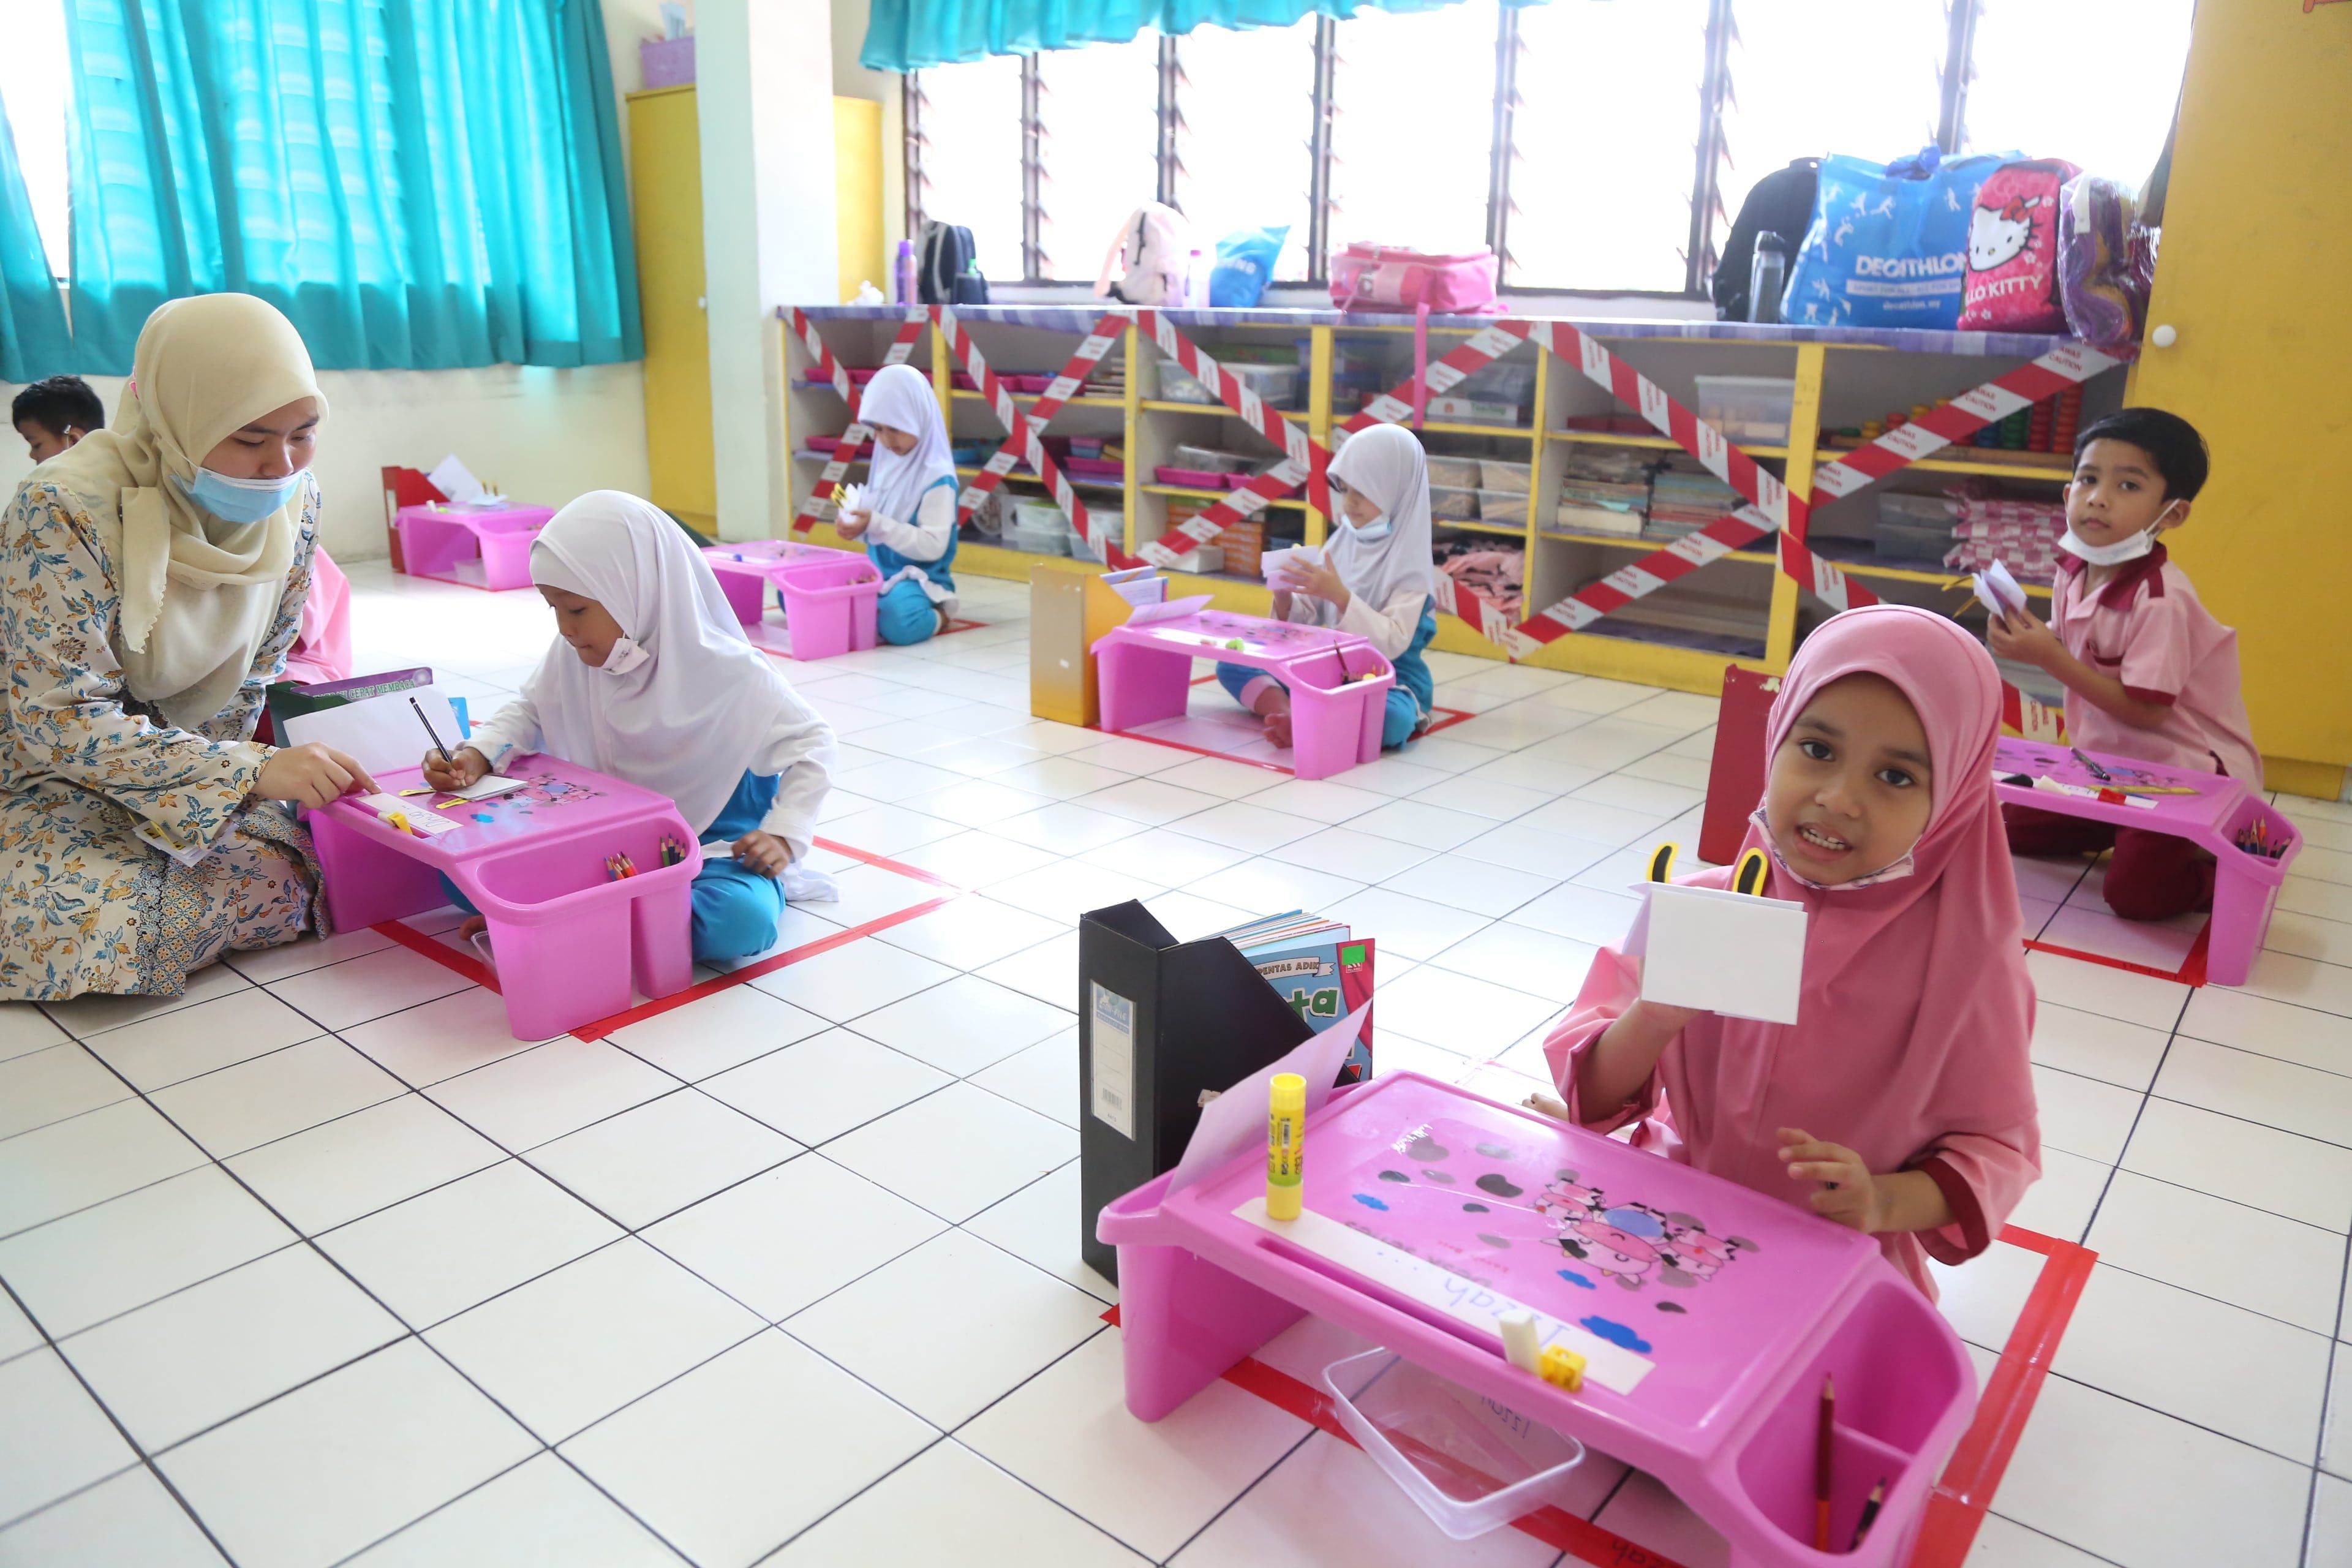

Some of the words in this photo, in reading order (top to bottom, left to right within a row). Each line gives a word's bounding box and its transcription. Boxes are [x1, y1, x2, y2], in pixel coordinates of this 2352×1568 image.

[1965, 285, 1986, 307] LLO
[1989, 274, 2043, 298] KITTY
[2048, 353, 2082, 372] CAUTION
[1965, 393, 1997, 412] CAUTION
[349, 685, 375, 700] CEPAT
[376, 679, 416, 695] MEMBACA
[1258, 963, 1292, 975] PENTAS
[1295, 961, 1319, 971] ADIK
[1286, 987, 1340, 1024] ta
[1444, 1277, 1571, 1348] Izah
